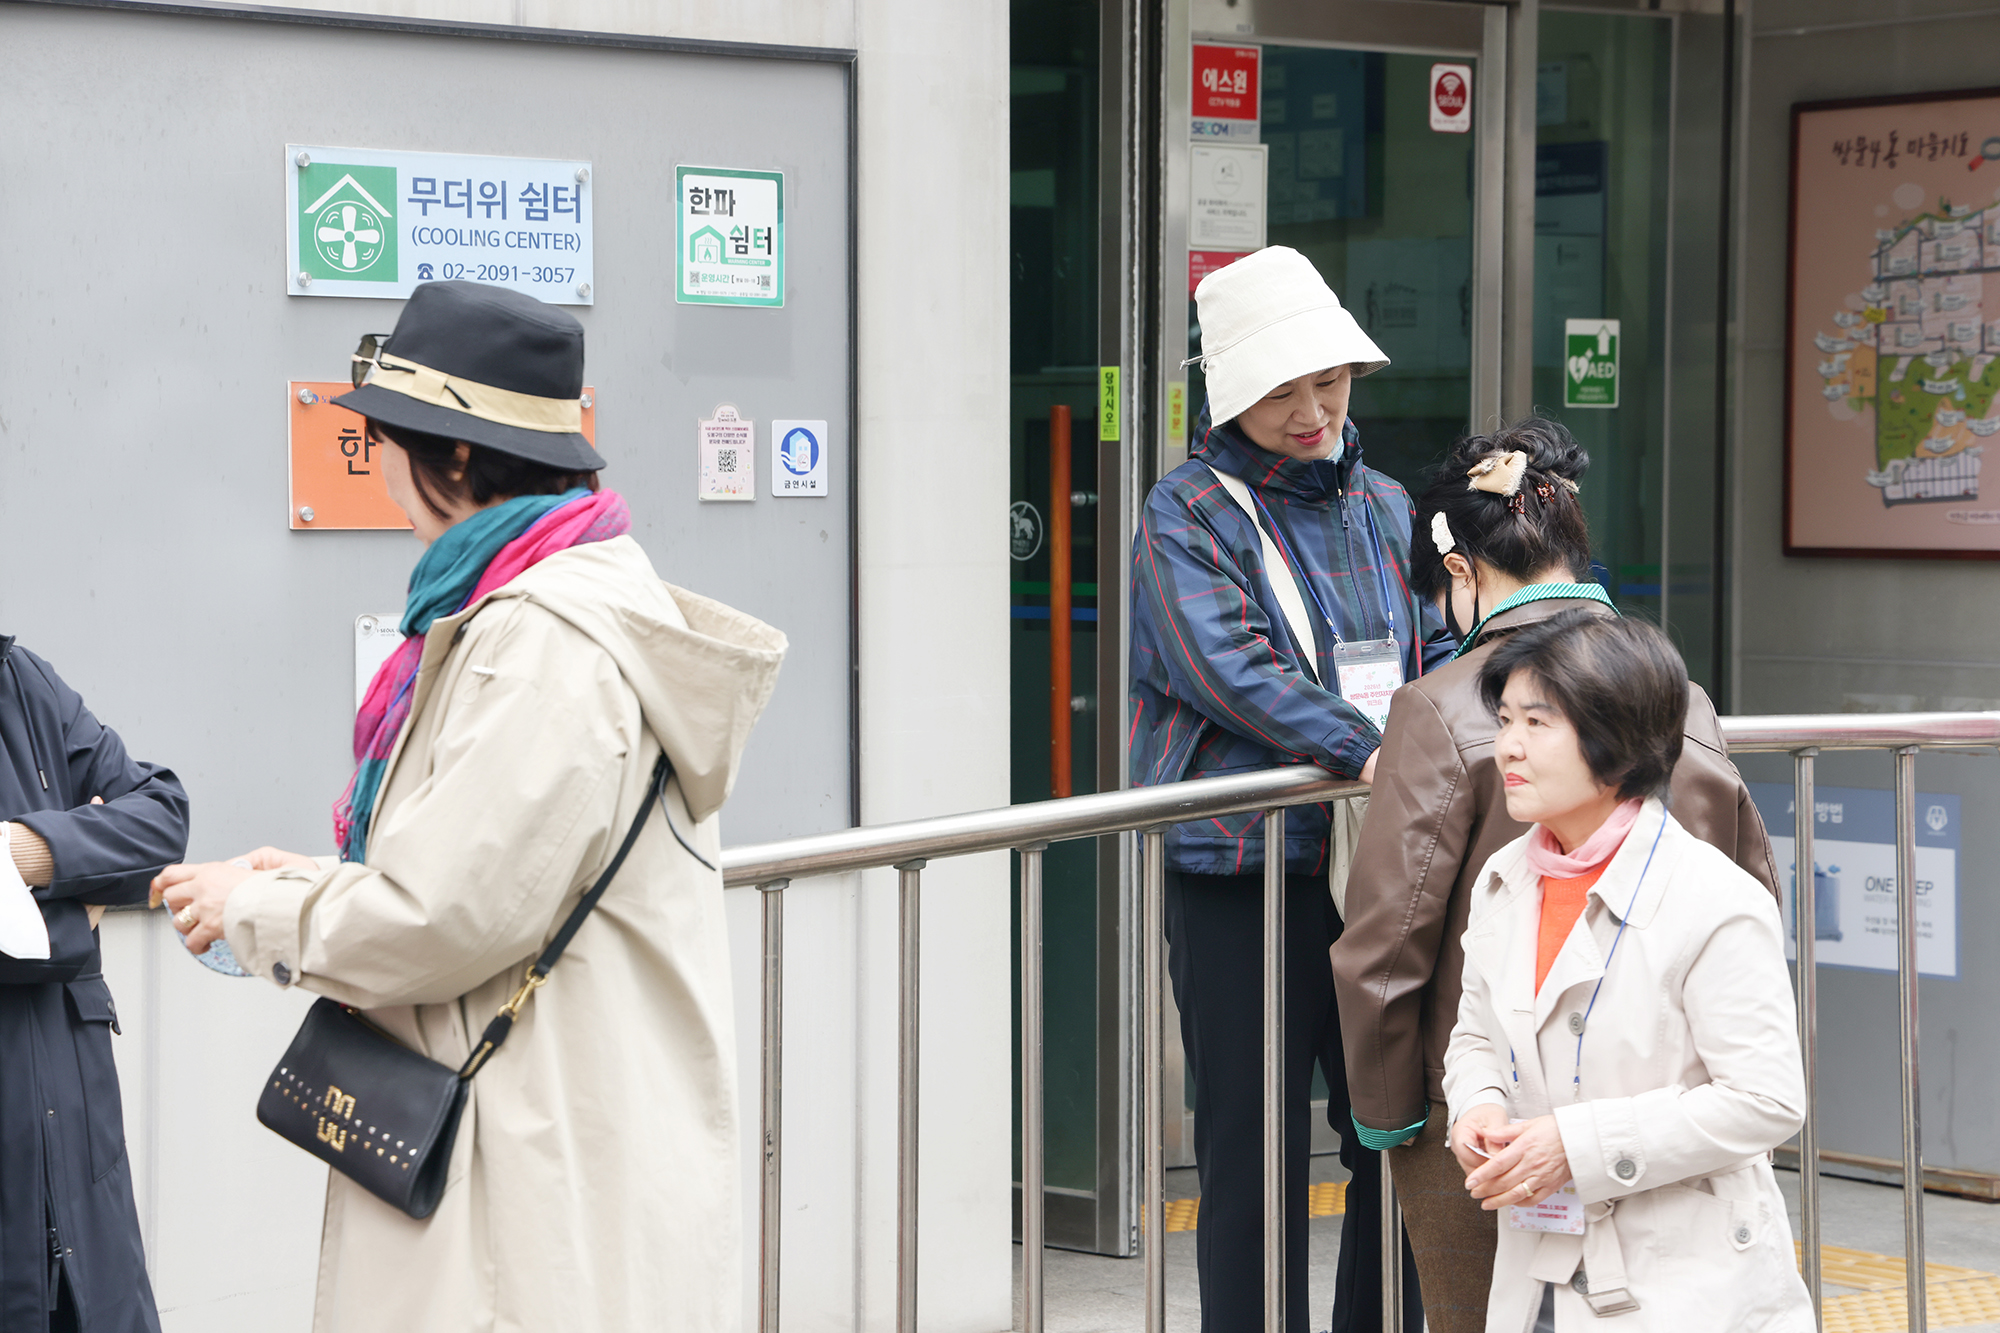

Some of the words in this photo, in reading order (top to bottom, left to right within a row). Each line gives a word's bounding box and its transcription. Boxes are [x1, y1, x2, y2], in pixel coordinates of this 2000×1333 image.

[1202, 68, 1248, 95] 에스원
[1437, 94, 1465, 108] SEOUL
[1191, 121, 1229, 136] SECOM
[1906, 131, 1969, 163] 마을지도
[407, 176, 508, 221] 무더위
[518, 181, 582, 224] 쉼터
[689, 186, 736, 217] 한파
[411, 226, 500, 248] (COOLING
[504, 231, 582, 253] CENTER)
[729, 224, 772, 255] 쉼터
[442, 262, 576, 284] 02-2091-3057
[701, 273, 730, 284] 운영시간
[1587, 361, 1616, 379] AED
[1104, 371, 1115, 424] 당기시오
[784, 480, 817, 489] 금연시설
[1865, 876, 1895, 893] ONE
